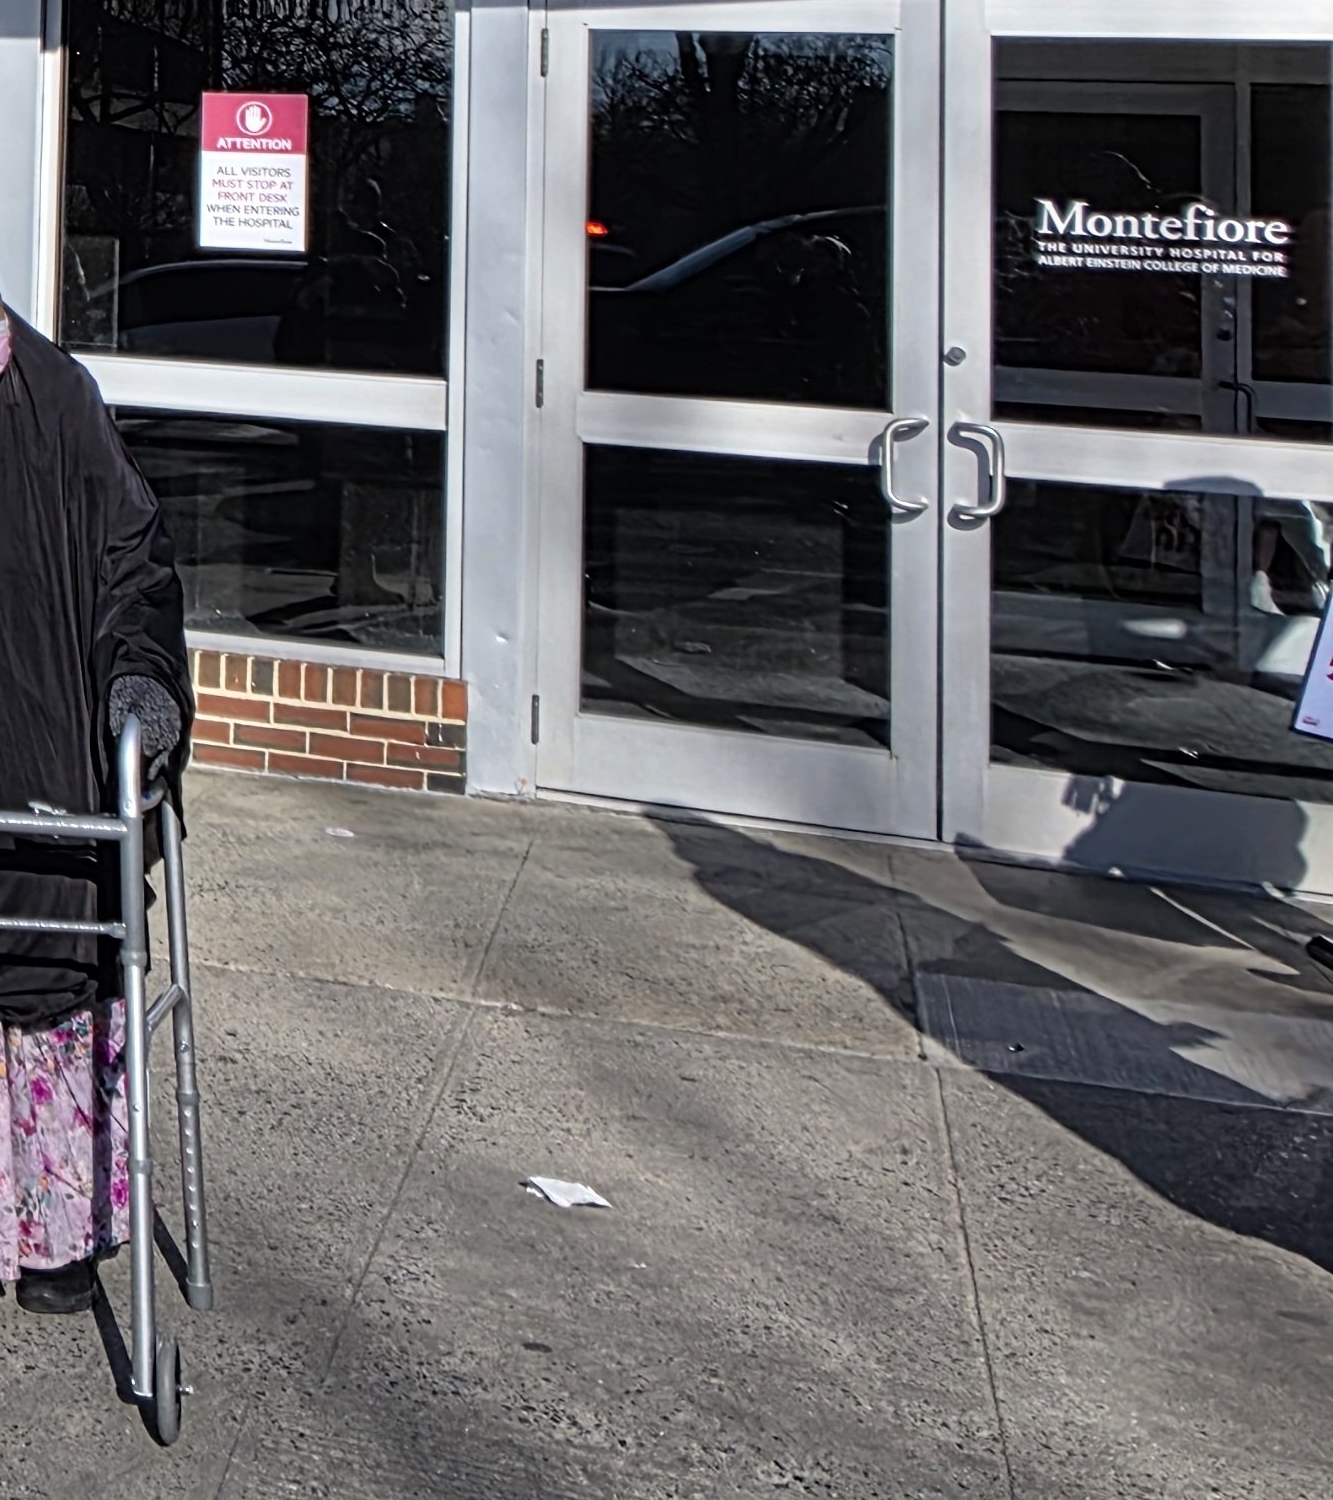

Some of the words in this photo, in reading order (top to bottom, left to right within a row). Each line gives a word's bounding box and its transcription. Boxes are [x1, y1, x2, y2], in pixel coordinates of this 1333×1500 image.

[216, 137, 292, 150] ATTENTION
[216, 166, 238, 176] ALL
[241, 167, 292, 177] VISITORS
[211, 180, 243, 189] MUST
[247, 180, 277, 190] STOP
[279, 181, 294, 190] AT
[217, 192, 254, 202] FRONT
[259, 193, 287, 203] DESK
[207, 204, 241, 214] WHEN
[244, 205, 300, 217] ENTERING
[213, 216, 235, 226] THE
[238, 217, 293, 229] HOSPITAL
[1035, 199, 1289, 245] Montefiore
[1038, 241, 1067, 253] THE
[1071, 243, 1165, 257] UNIVERSITY
[1169, 248, 1247, 261] HOSPITAL
[1252, 251, 1284, 263] FOR
[1038, 255, 1084, 268] ALBERT
[1086, 257, 1142, 270] EINSTEIN
[1143, 259, 1199, 273] COLLEGE
[1201, 261, 1221, 274] OF
[1222, 263, 1287, 277] MEDICINE
